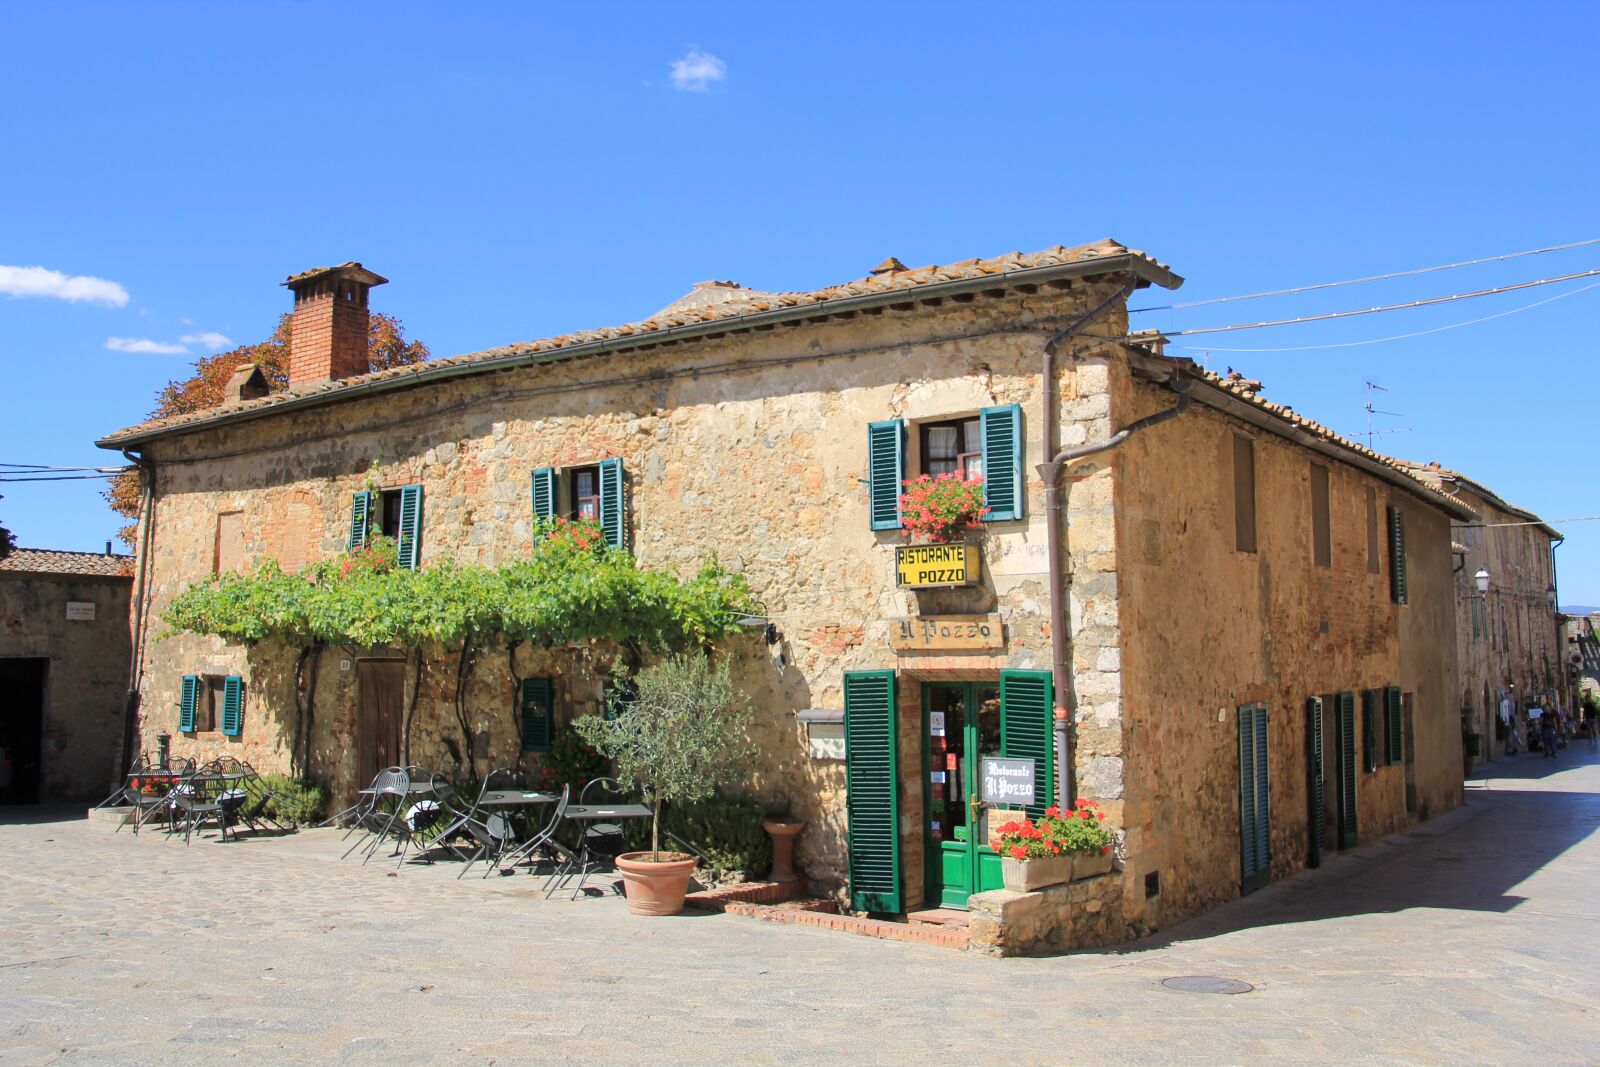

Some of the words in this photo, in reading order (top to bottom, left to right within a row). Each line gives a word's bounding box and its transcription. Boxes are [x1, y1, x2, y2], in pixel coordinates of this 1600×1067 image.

[898, 545, 964, 565] RISTORANTE
[898, 572, 911, 585] IL
[919, 568, 964, 584] POZZO
[987, 761, 1030, 777] Ristorante
[985, 776, 998, 797] Il
[998, 776, 1033, 799] Pozzo
